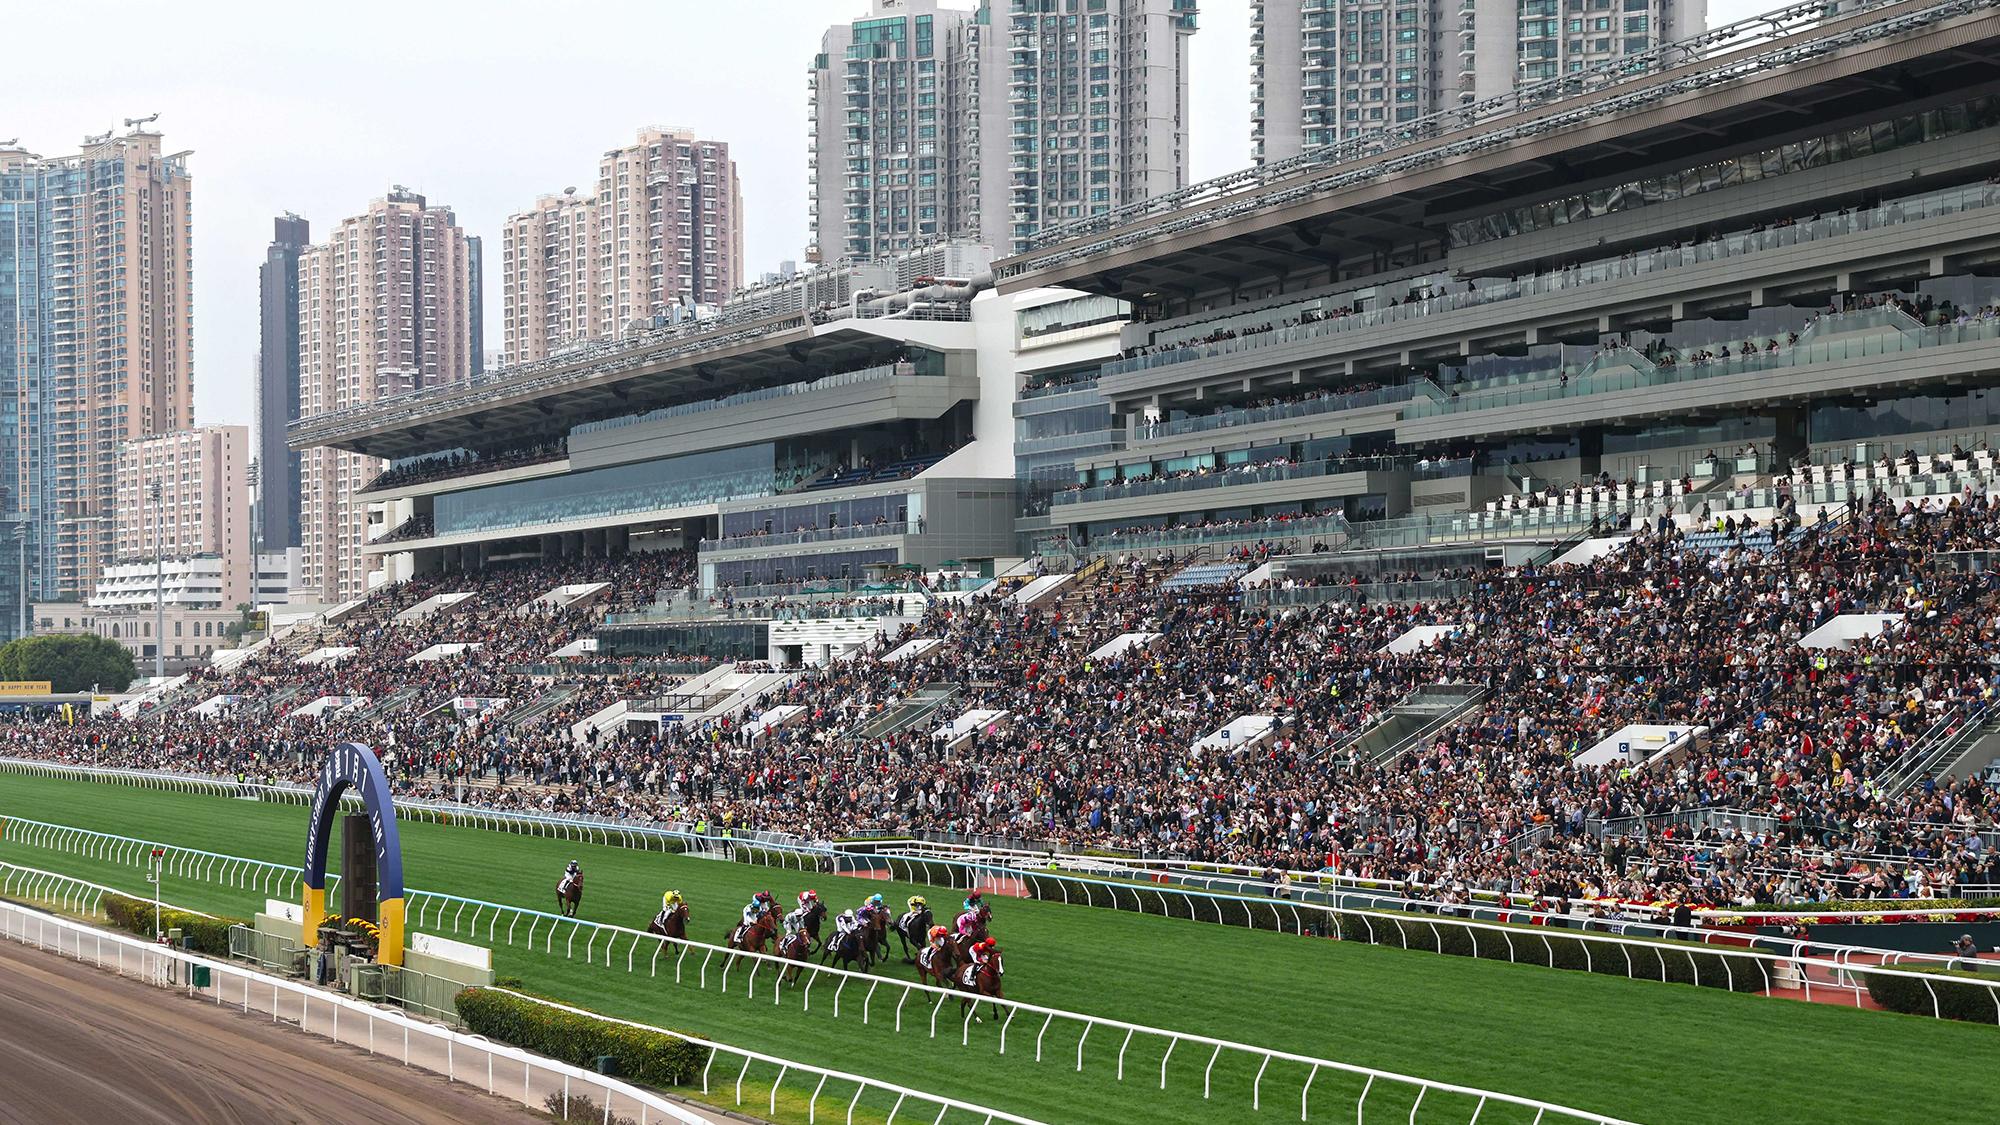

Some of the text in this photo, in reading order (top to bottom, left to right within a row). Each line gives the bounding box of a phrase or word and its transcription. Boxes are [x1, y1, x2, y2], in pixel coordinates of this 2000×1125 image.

[306, 784, 324, 870] LUCKY START
[373, 810, 382, 843] JAN
